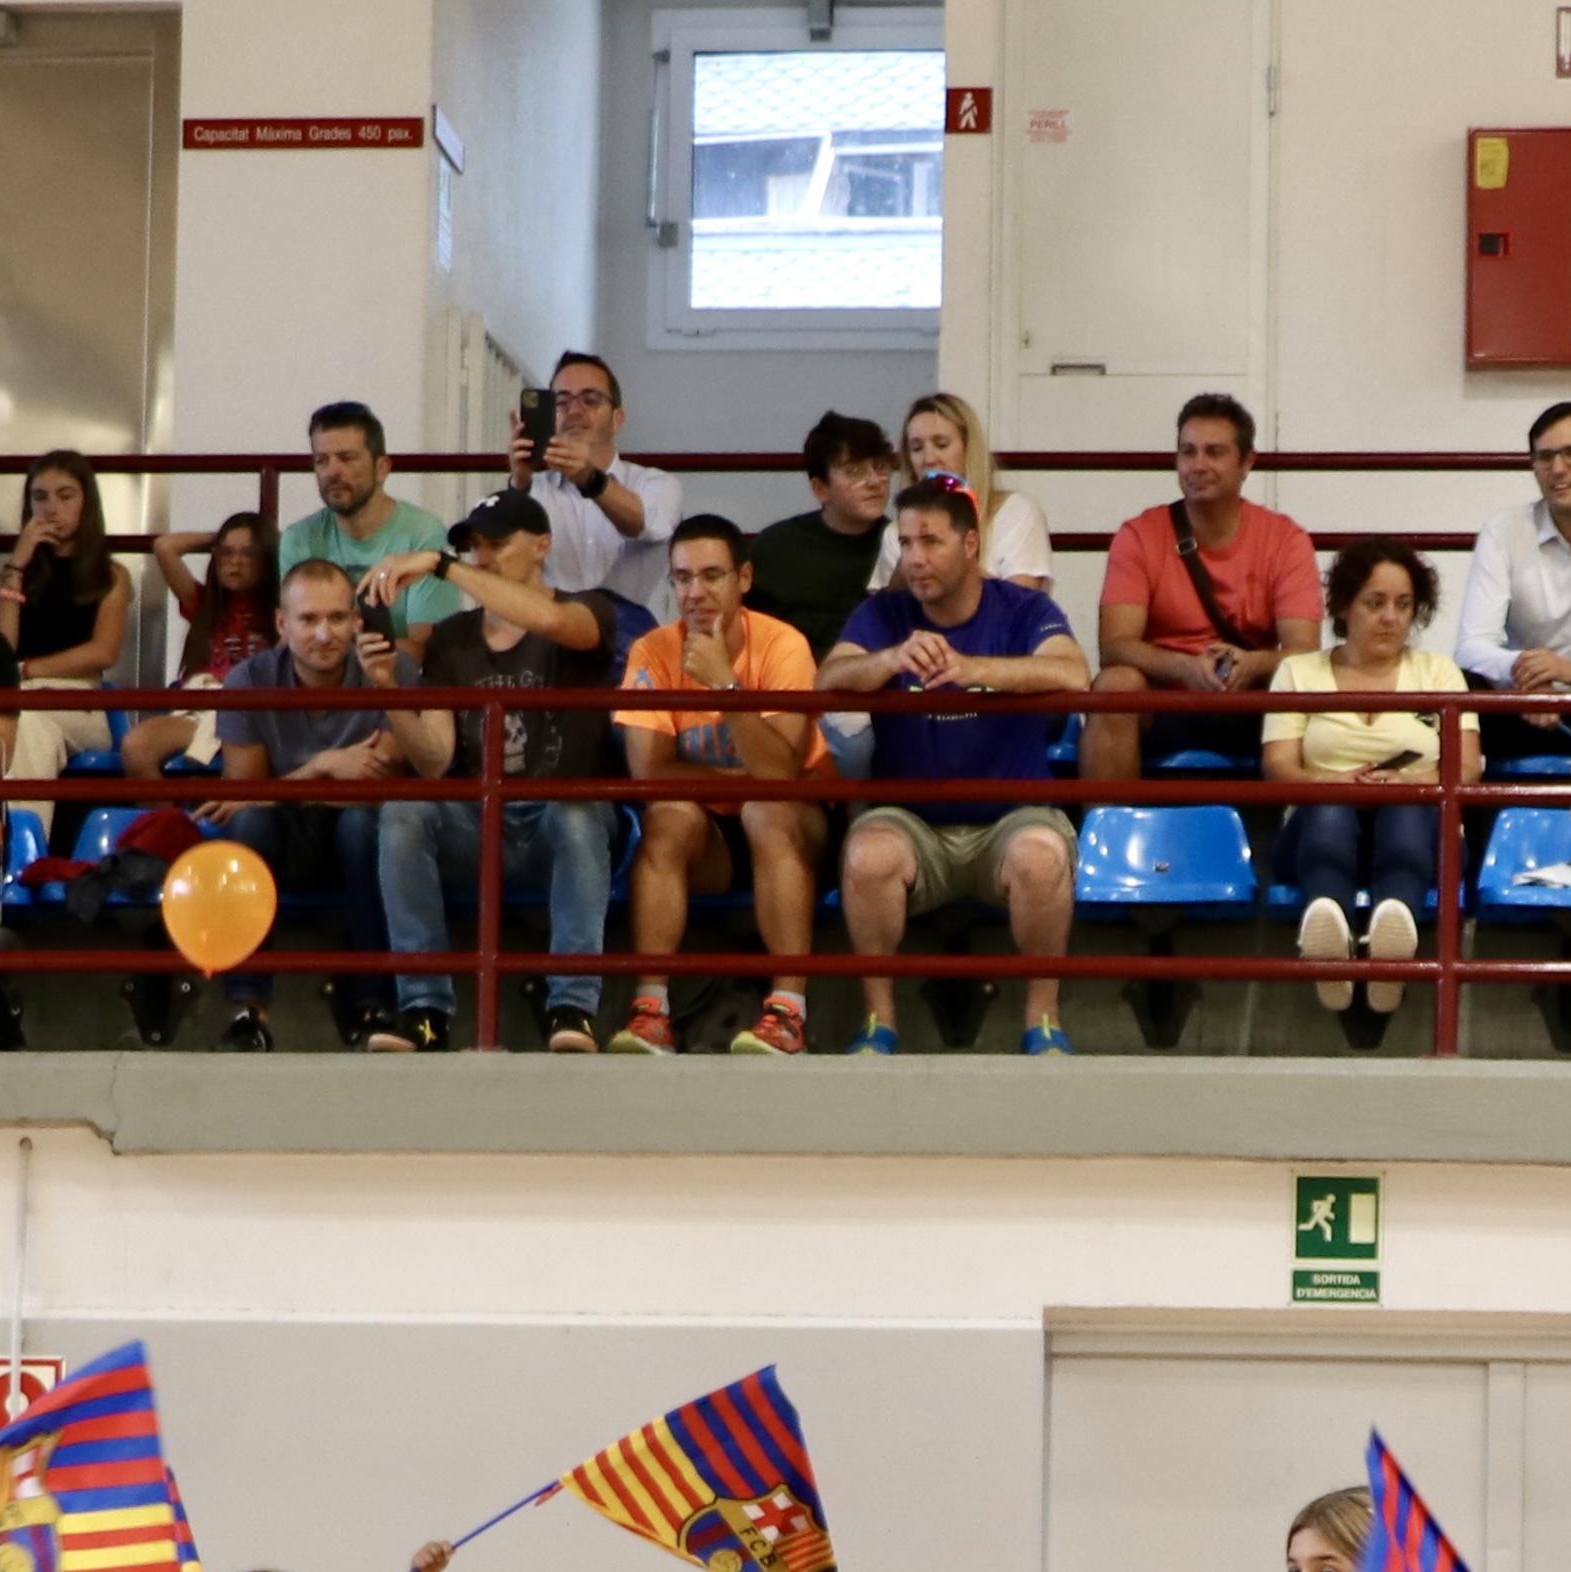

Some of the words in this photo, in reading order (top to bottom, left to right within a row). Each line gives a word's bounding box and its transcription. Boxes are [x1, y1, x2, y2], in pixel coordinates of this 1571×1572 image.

[194, 126, 249, 143] Capacitat
[309, 126, 352, 141] Grades
[358, 125, 382, 140] 450
[388, 127, 413, 143] pax.
[1312, 1274, 1362, 1286] SORTIDA
